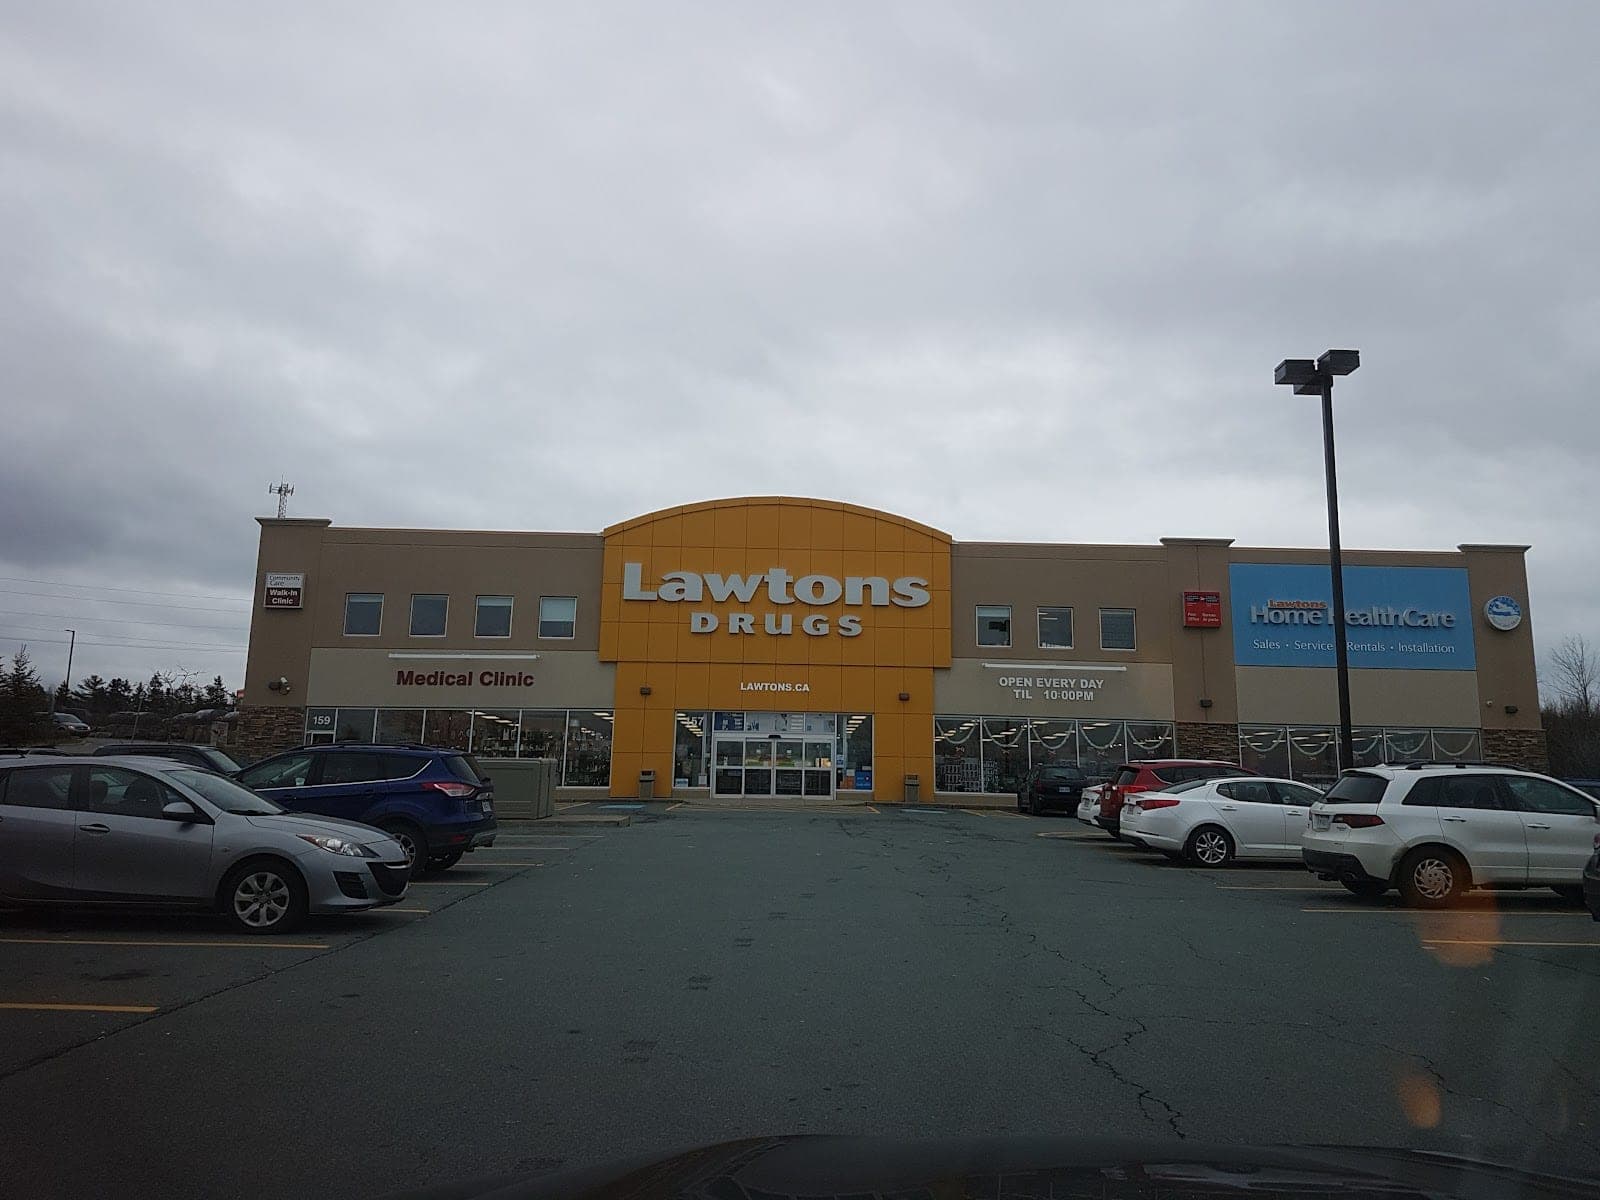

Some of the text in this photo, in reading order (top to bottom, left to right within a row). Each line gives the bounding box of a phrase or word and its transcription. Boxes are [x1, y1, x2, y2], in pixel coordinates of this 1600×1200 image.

[623, 562, 931, 607] Lawtons
[1268, 599, 1328, 609] Lawtons
[1250, 606, 1323, 625] Home
[690, 612, 863, 636] DRUGS
[1253, 639, 1455, 654] Sales Service Rentals Installation
[396, 670, 534, 687] Medical Clinic
[999, 676, 1104, 689] OPEN EVERY DAY
[740, 682, 810, 693] LAWTONS.CA
[1013, 689, 1094, 701] TIL 10:00PM
[313, 715, 331, 725] 159
